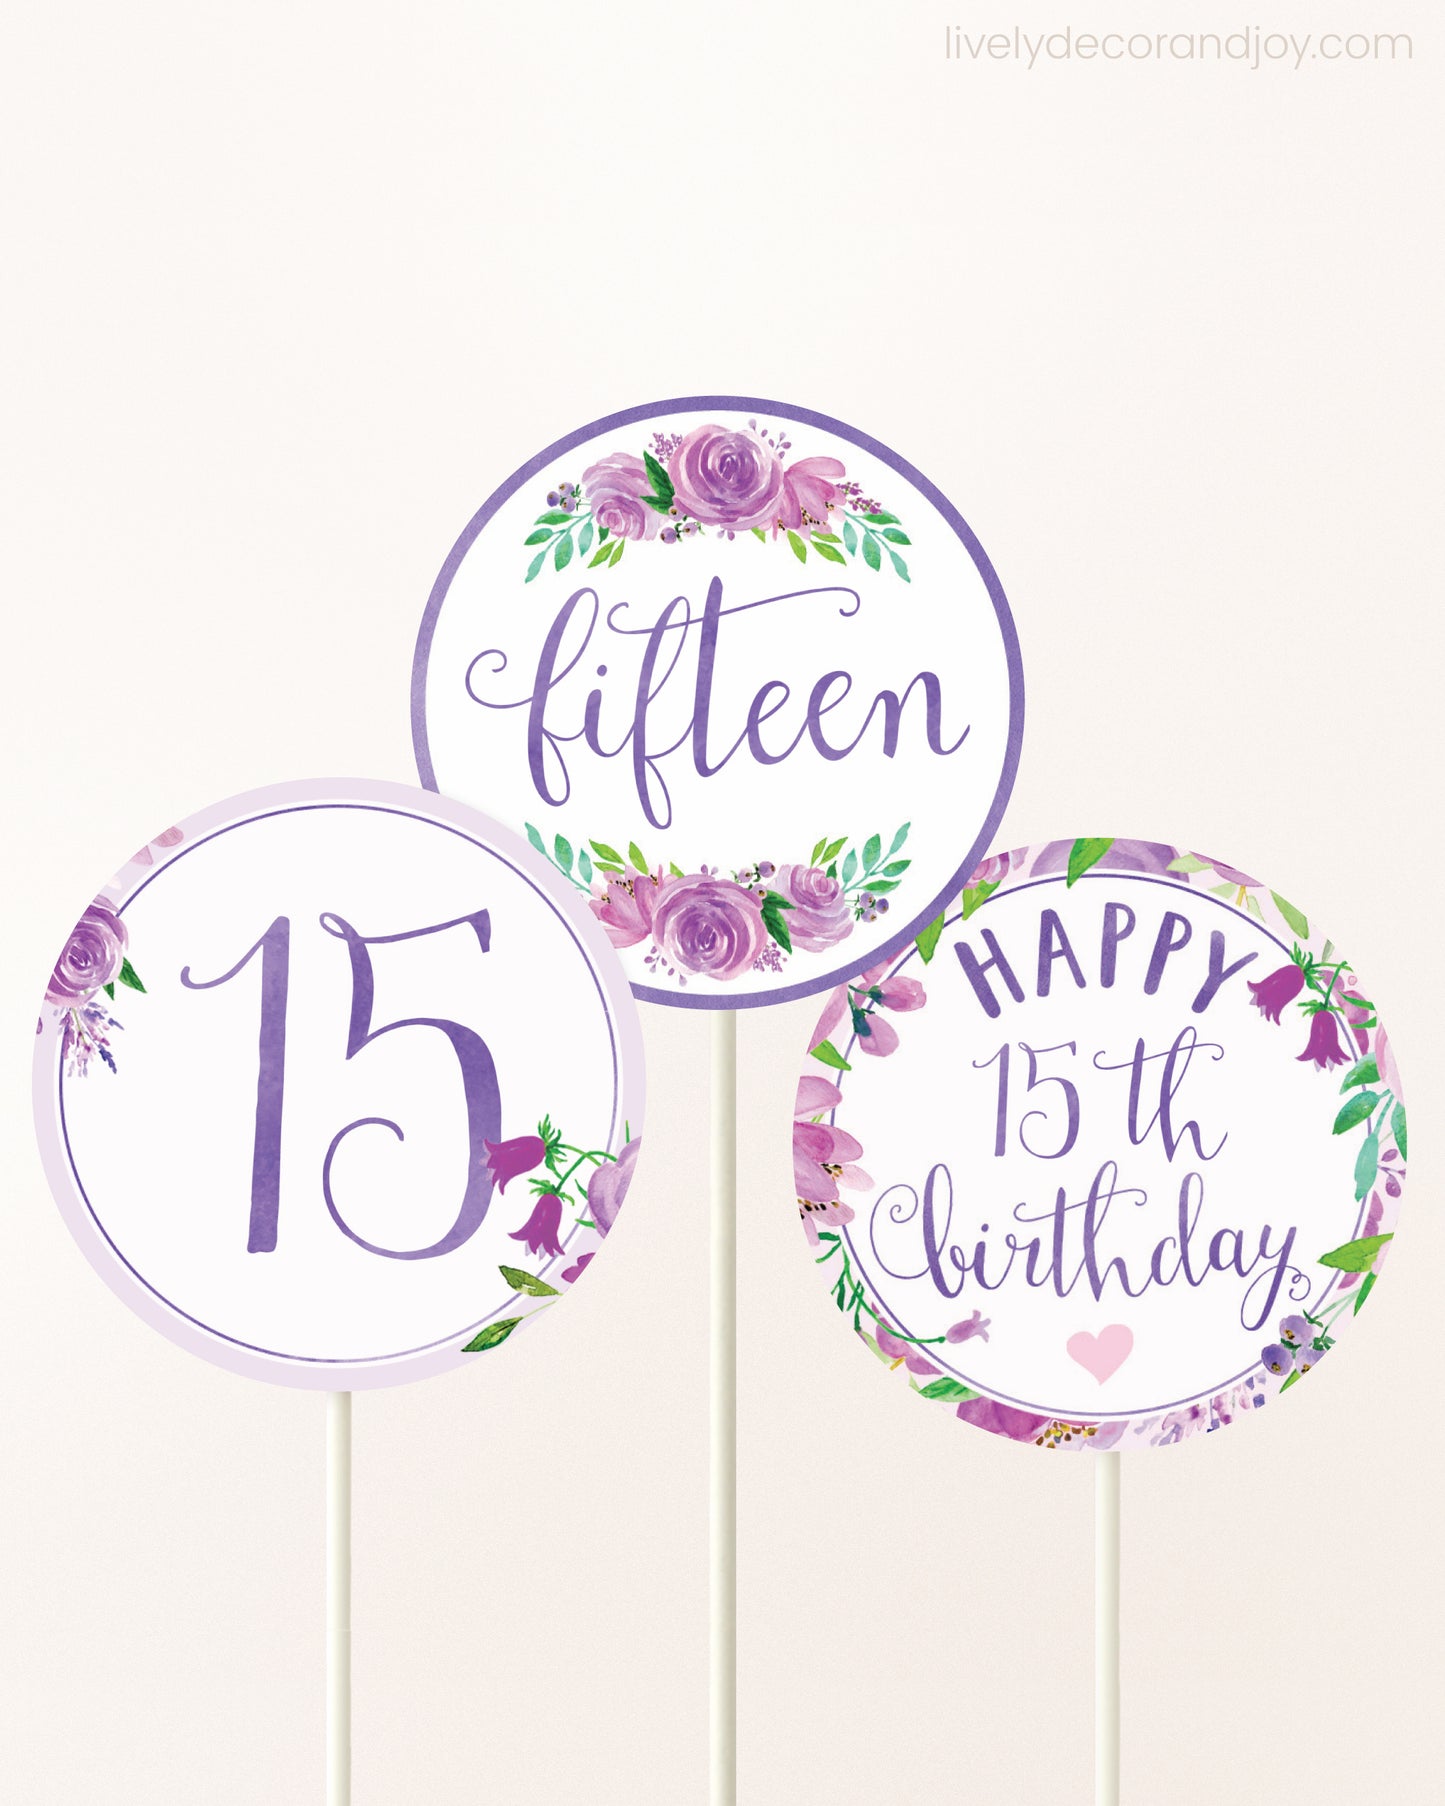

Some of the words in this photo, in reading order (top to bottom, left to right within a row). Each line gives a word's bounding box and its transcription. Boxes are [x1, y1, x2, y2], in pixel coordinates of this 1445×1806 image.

[465, 575, 971, 831] fifteen
[953, 902, 1259, 1018] HAPPY
[180, 908, 502, 1261] 15
[869, 1160, 1312, 1331] birthday
